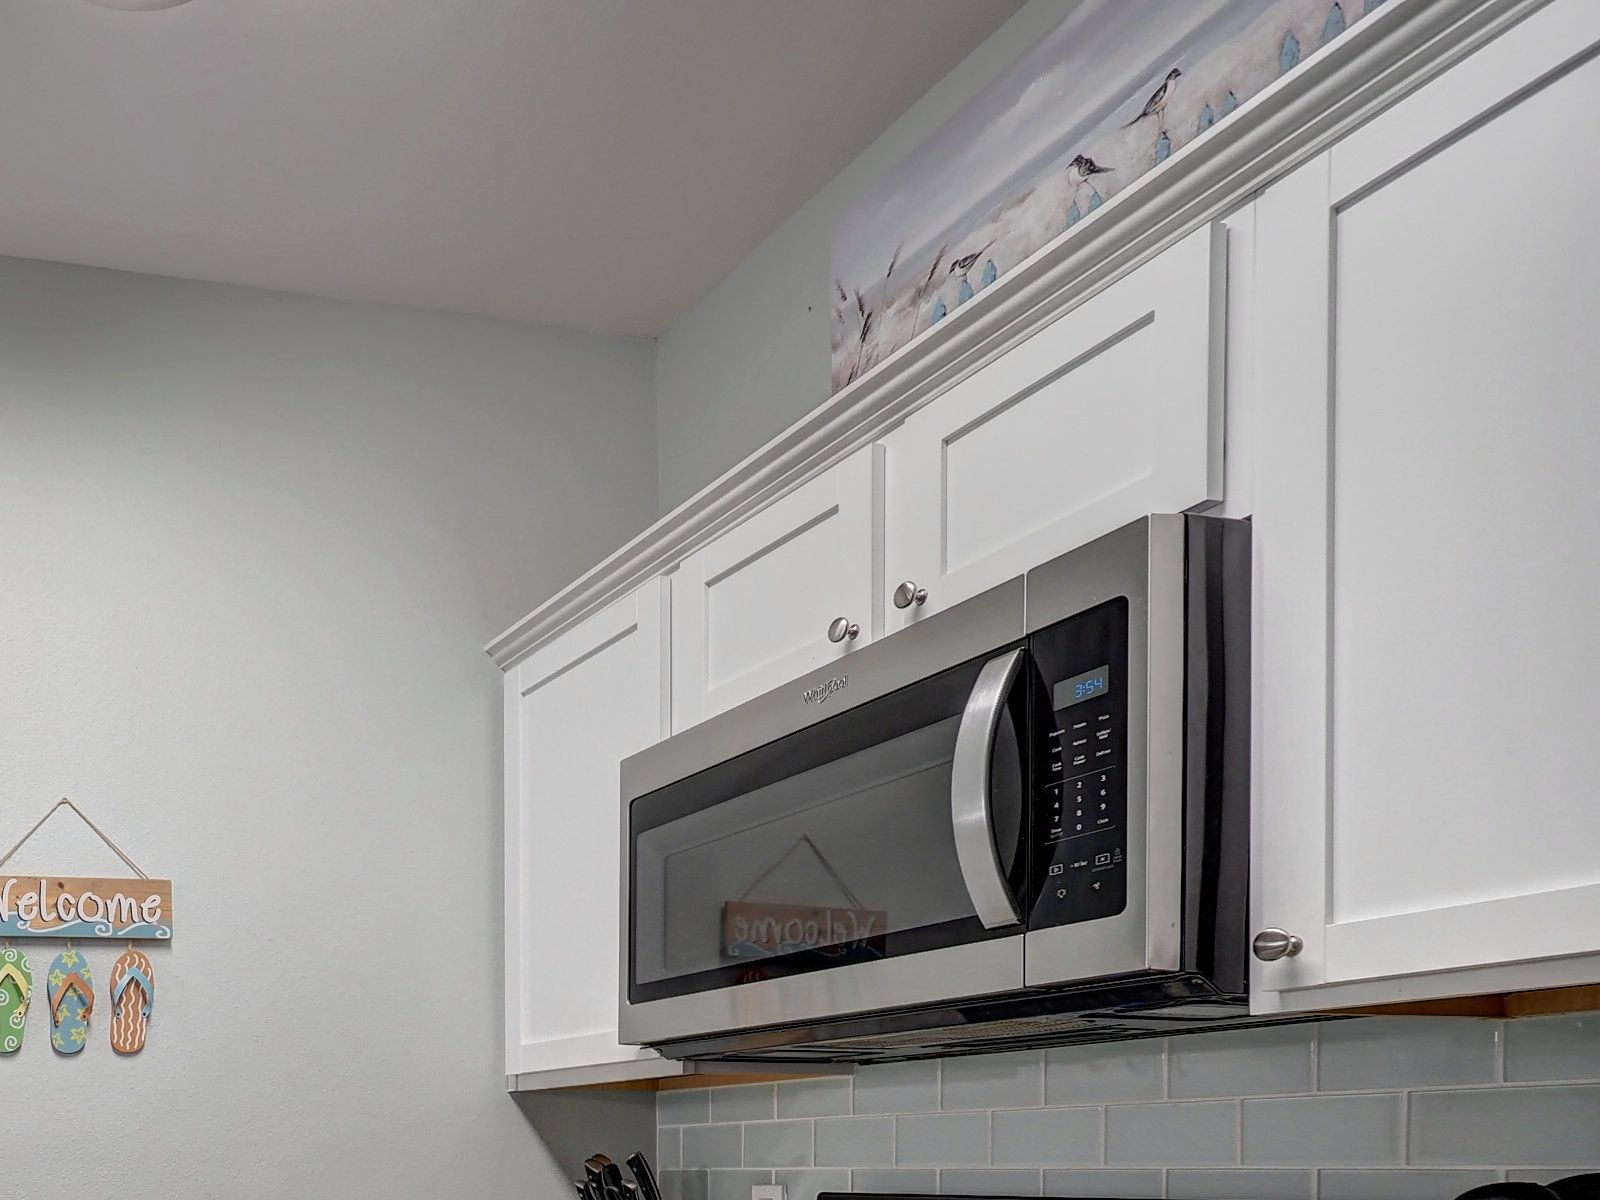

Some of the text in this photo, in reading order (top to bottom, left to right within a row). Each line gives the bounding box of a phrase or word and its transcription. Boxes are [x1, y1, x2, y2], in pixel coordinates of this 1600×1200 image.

[1075, 677, 1104, 698] 3:54
[1076, 781, 1082, 789] 2
[1100, 774, 1106, 782] 3
[1076, 795, 1082, 803] 5
[1100, 788, 1106, 796] 6
